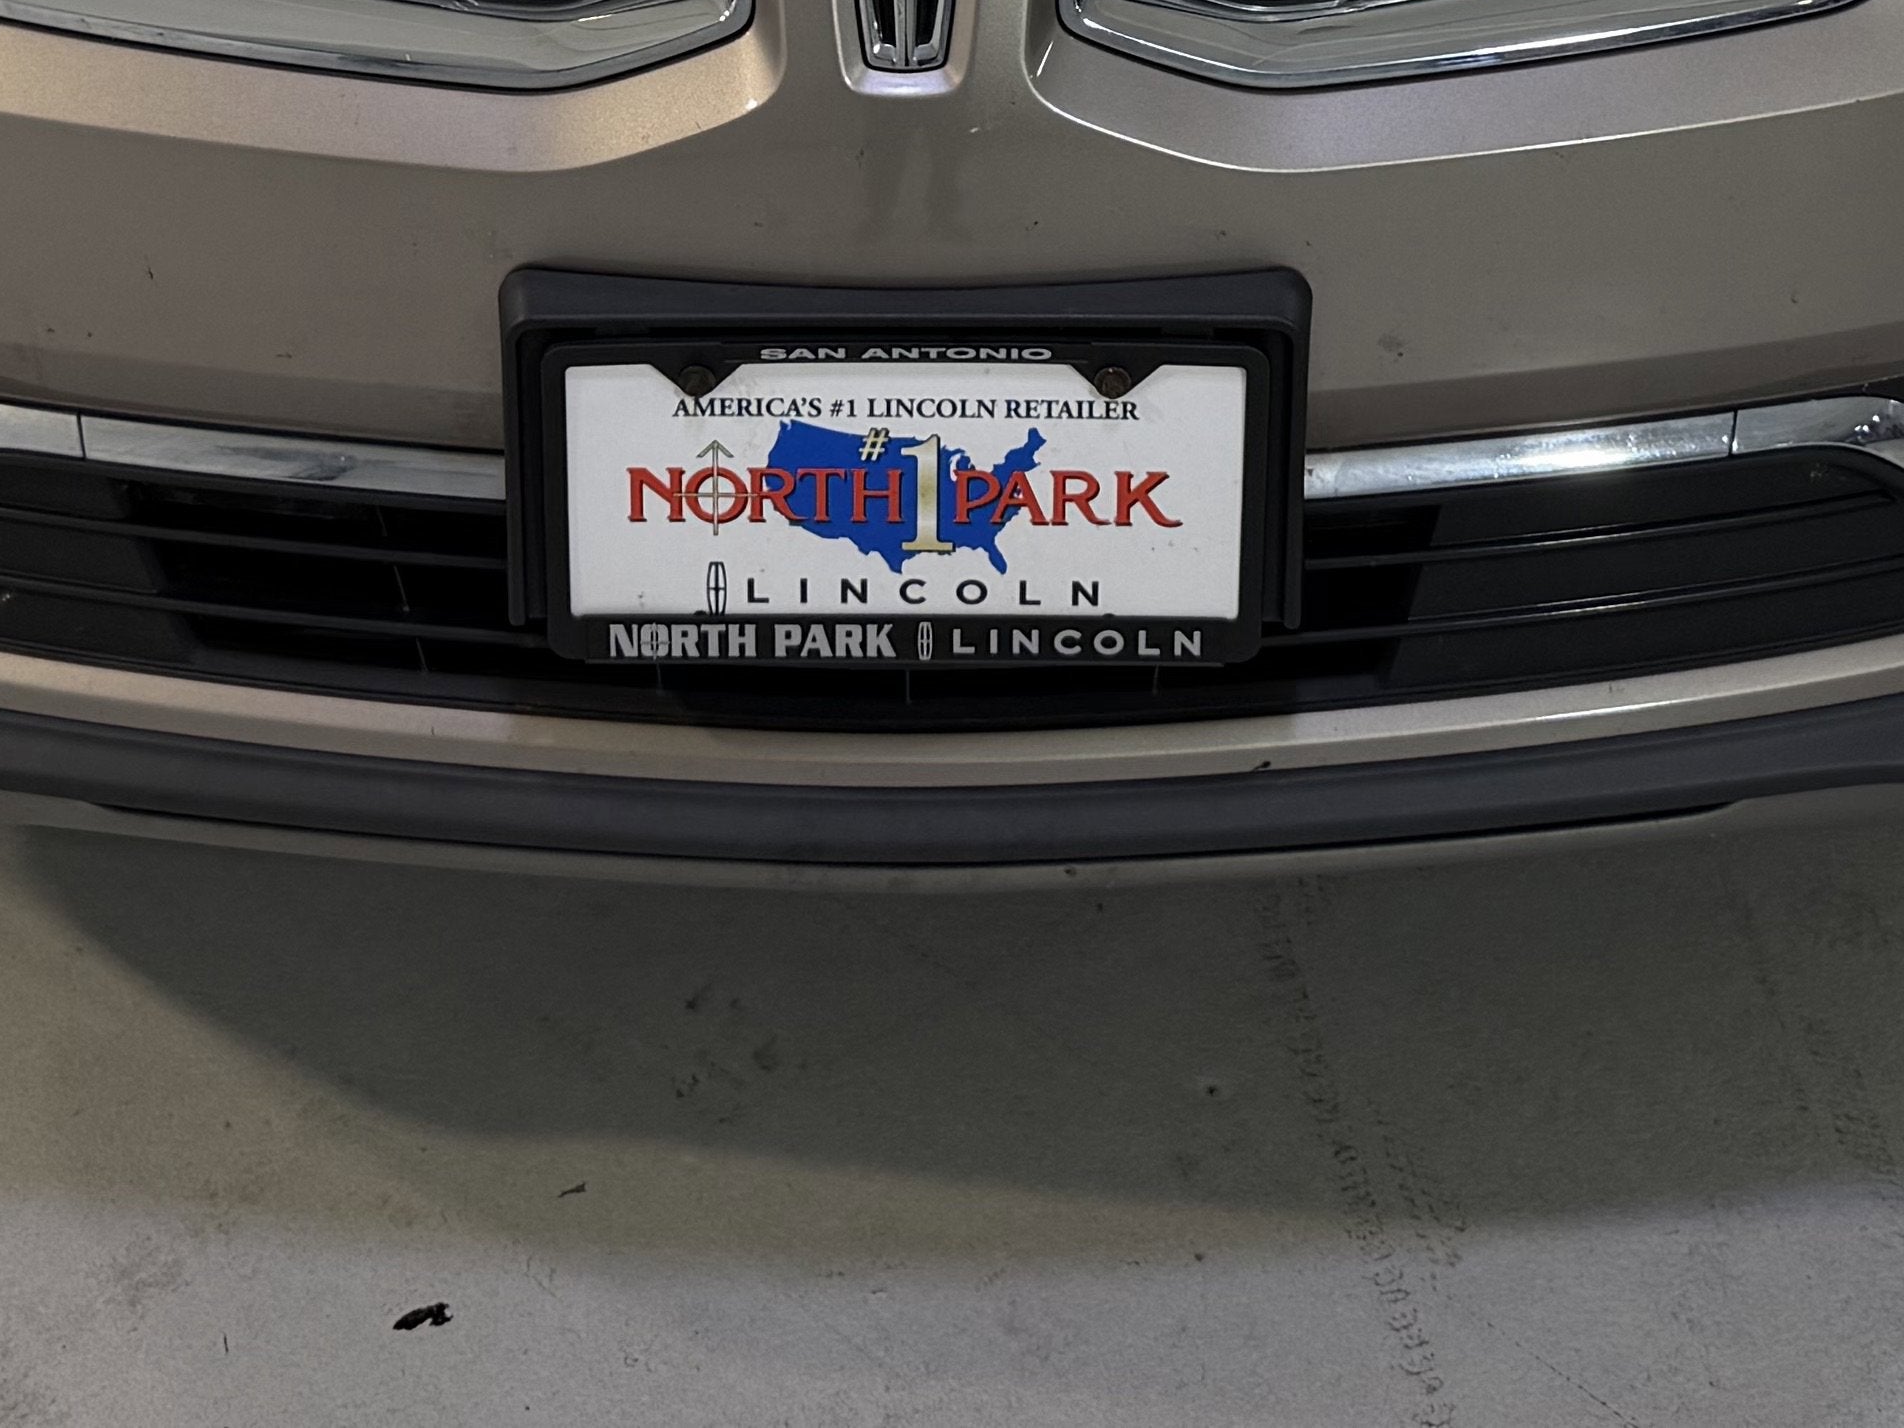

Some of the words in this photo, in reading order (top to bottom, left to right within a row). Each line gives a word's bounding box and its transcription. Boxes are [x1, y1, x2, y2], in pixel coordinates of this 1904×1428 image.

[760, 347, 846, 360] SAN
[861, 348, 1052, 361] ANTONIO
[830, 399, 857, 417] #1
[866, 398, 997, 419] LINCOLN
[1004, 399, 1140, 420] RETAILER
[626, 467, 906, 524] NORTH
[952, 469, 1184, 528] PARK
[747, 577, 1099, 607] LINCOLN
[609, 623, 757, 659] NORTH
[774, 623, 897, 658] PARK
[952, 628, 1202, 657] LINCOLN
